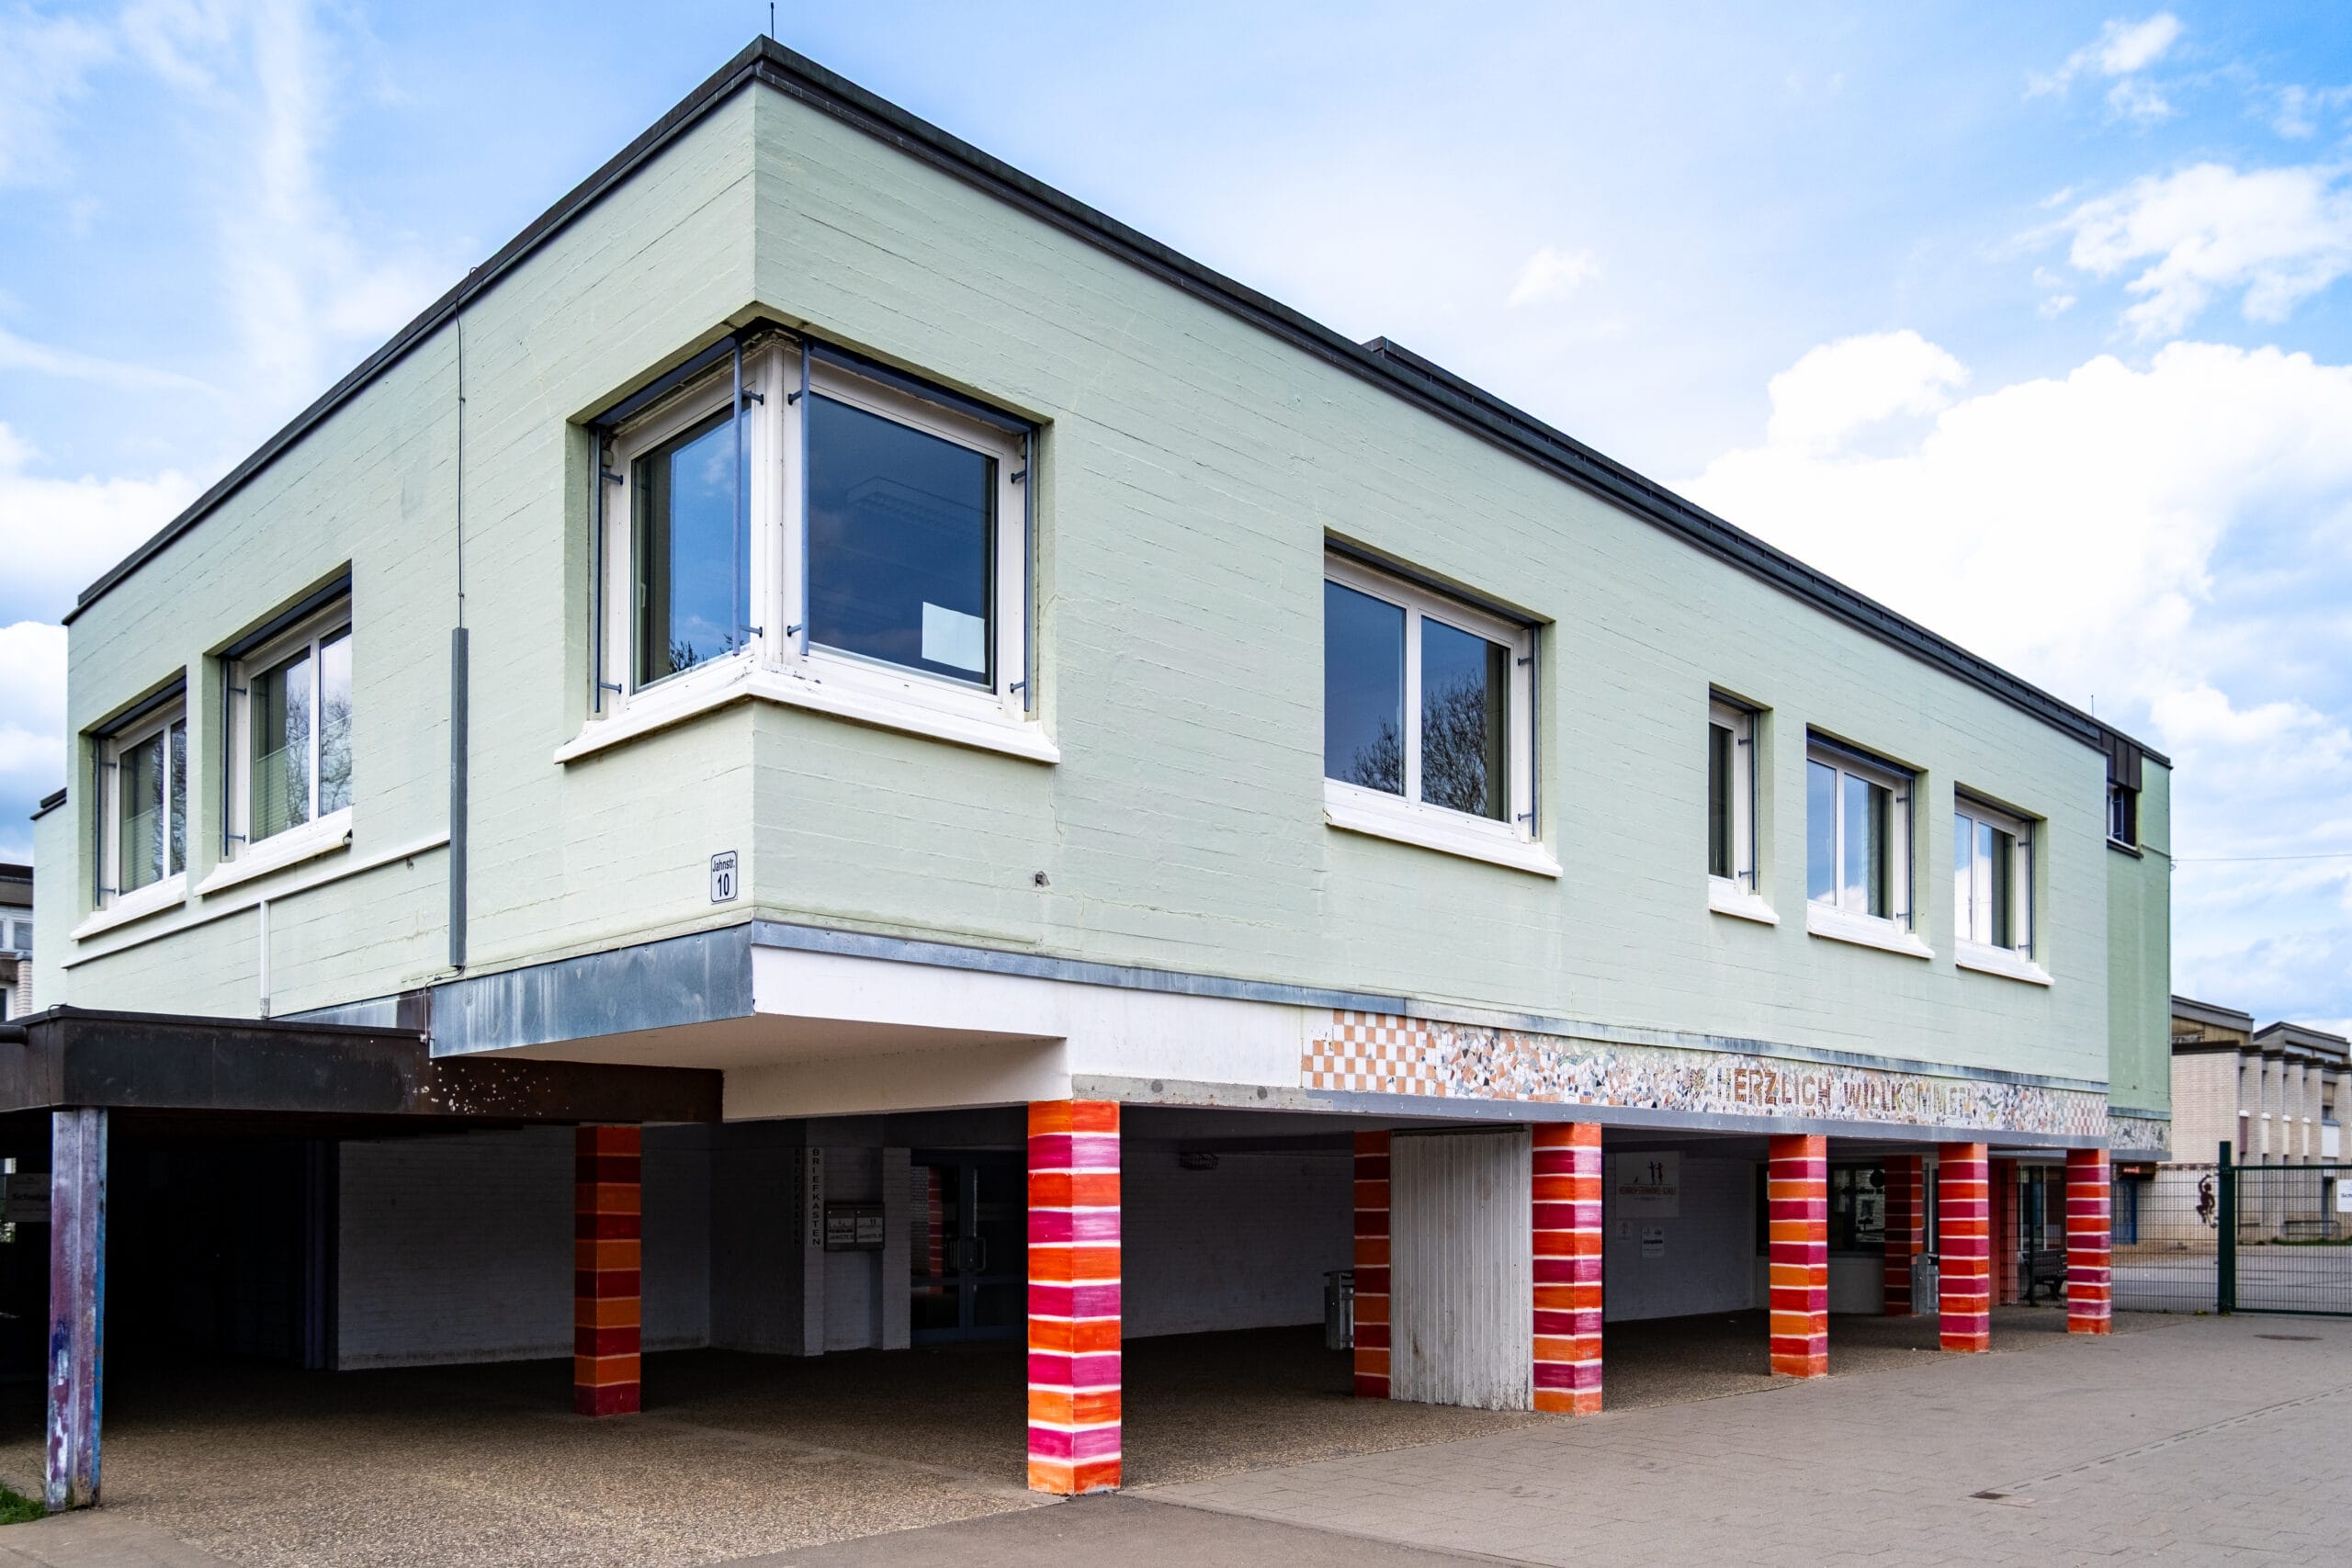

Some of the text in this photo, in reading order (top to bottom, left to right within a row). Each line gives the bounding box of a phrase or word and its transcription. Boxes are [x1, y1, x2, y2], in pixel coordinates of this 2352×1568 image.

[713, 858, 735, 872] Jahnstr.
[718, 873, 729, 897] 10
[1717, 1067, 1973, 1118] HERZLICH WILLKOMMEN
[812, 1149, 820, 1246] BRIEFKASTEN
